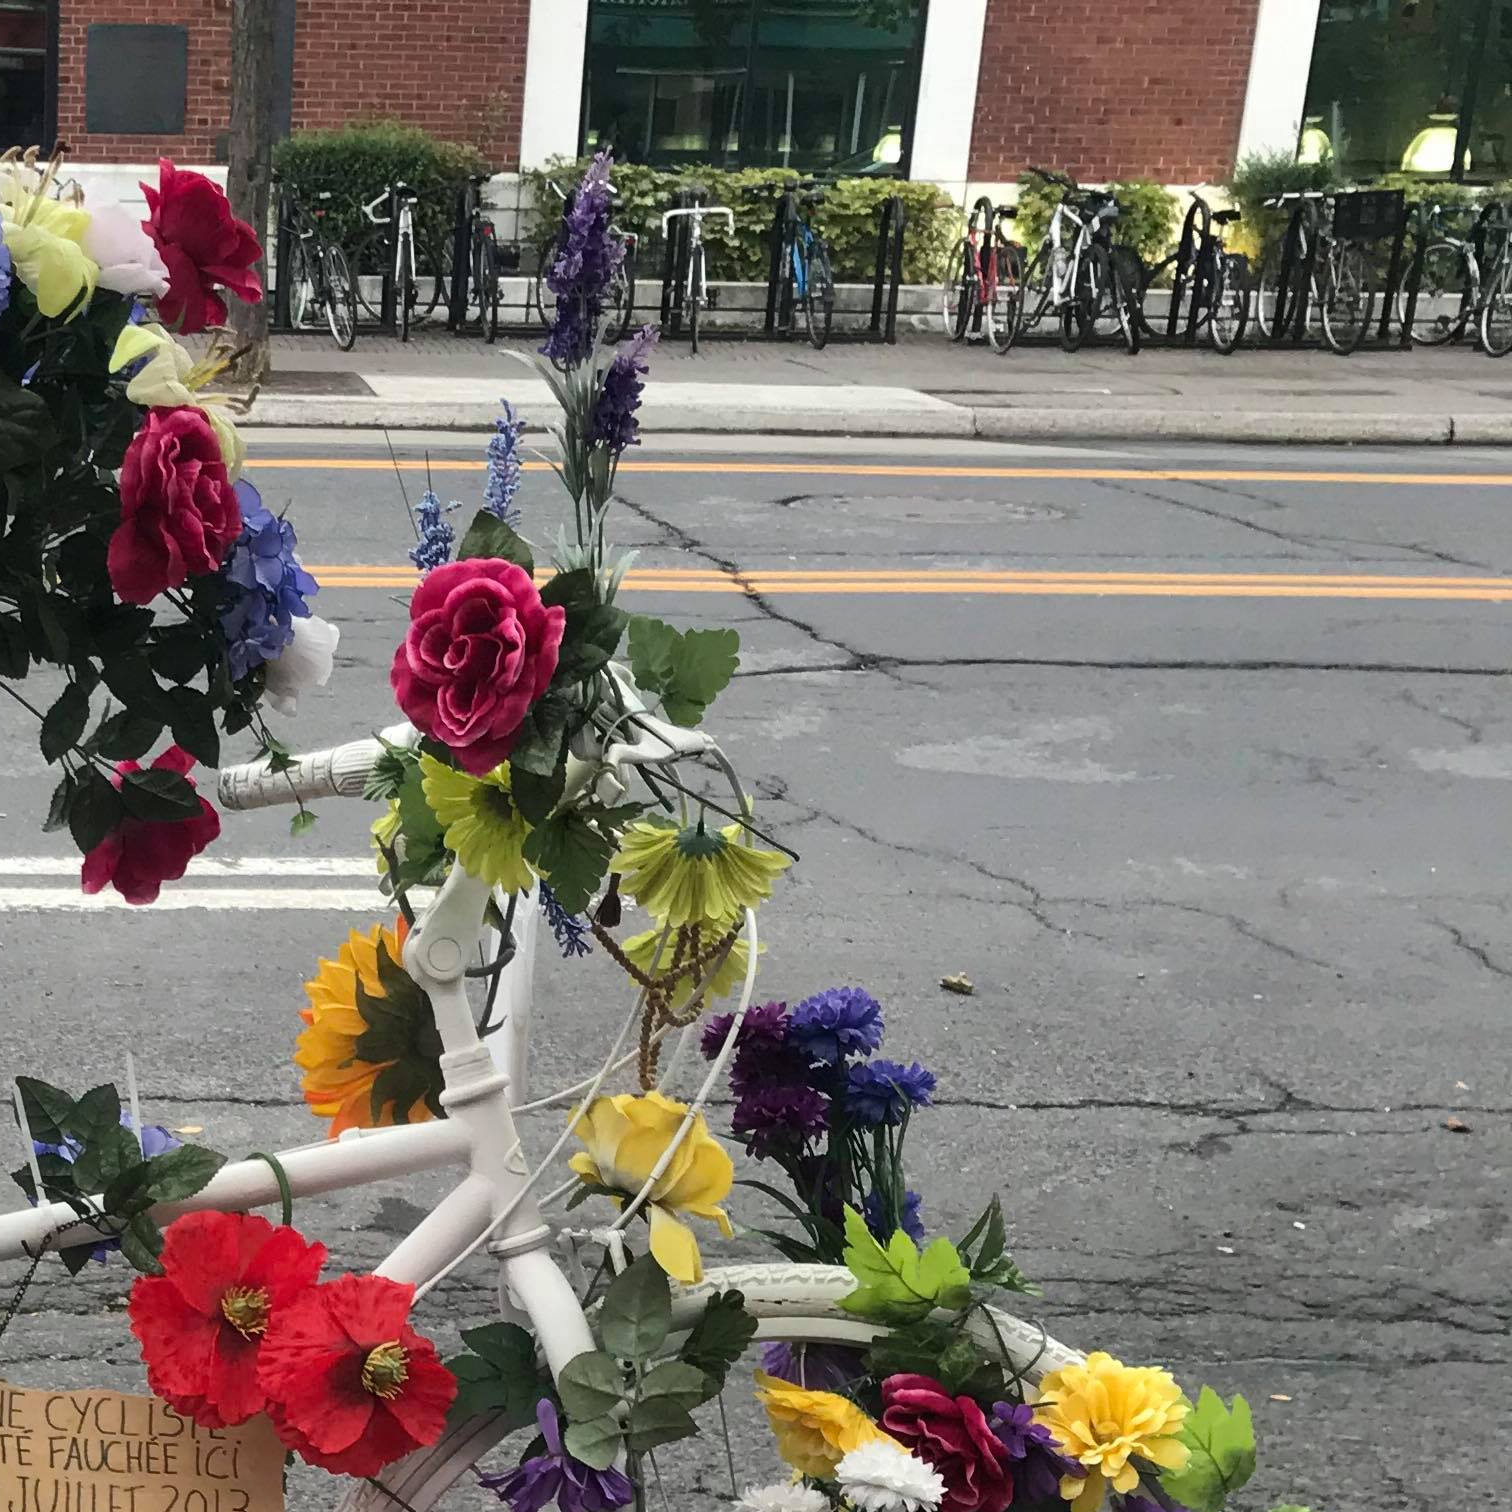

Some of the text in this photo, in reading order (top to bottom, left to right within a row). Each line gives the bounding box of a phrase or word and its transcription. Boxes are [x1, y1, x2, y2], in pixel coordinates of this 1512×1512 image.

[44, 1395, 227, 1441] CYCLIS
[48, 1435, 179, 1475] FAUCHÉE
[194, 1440, 242, 1480] ICI
